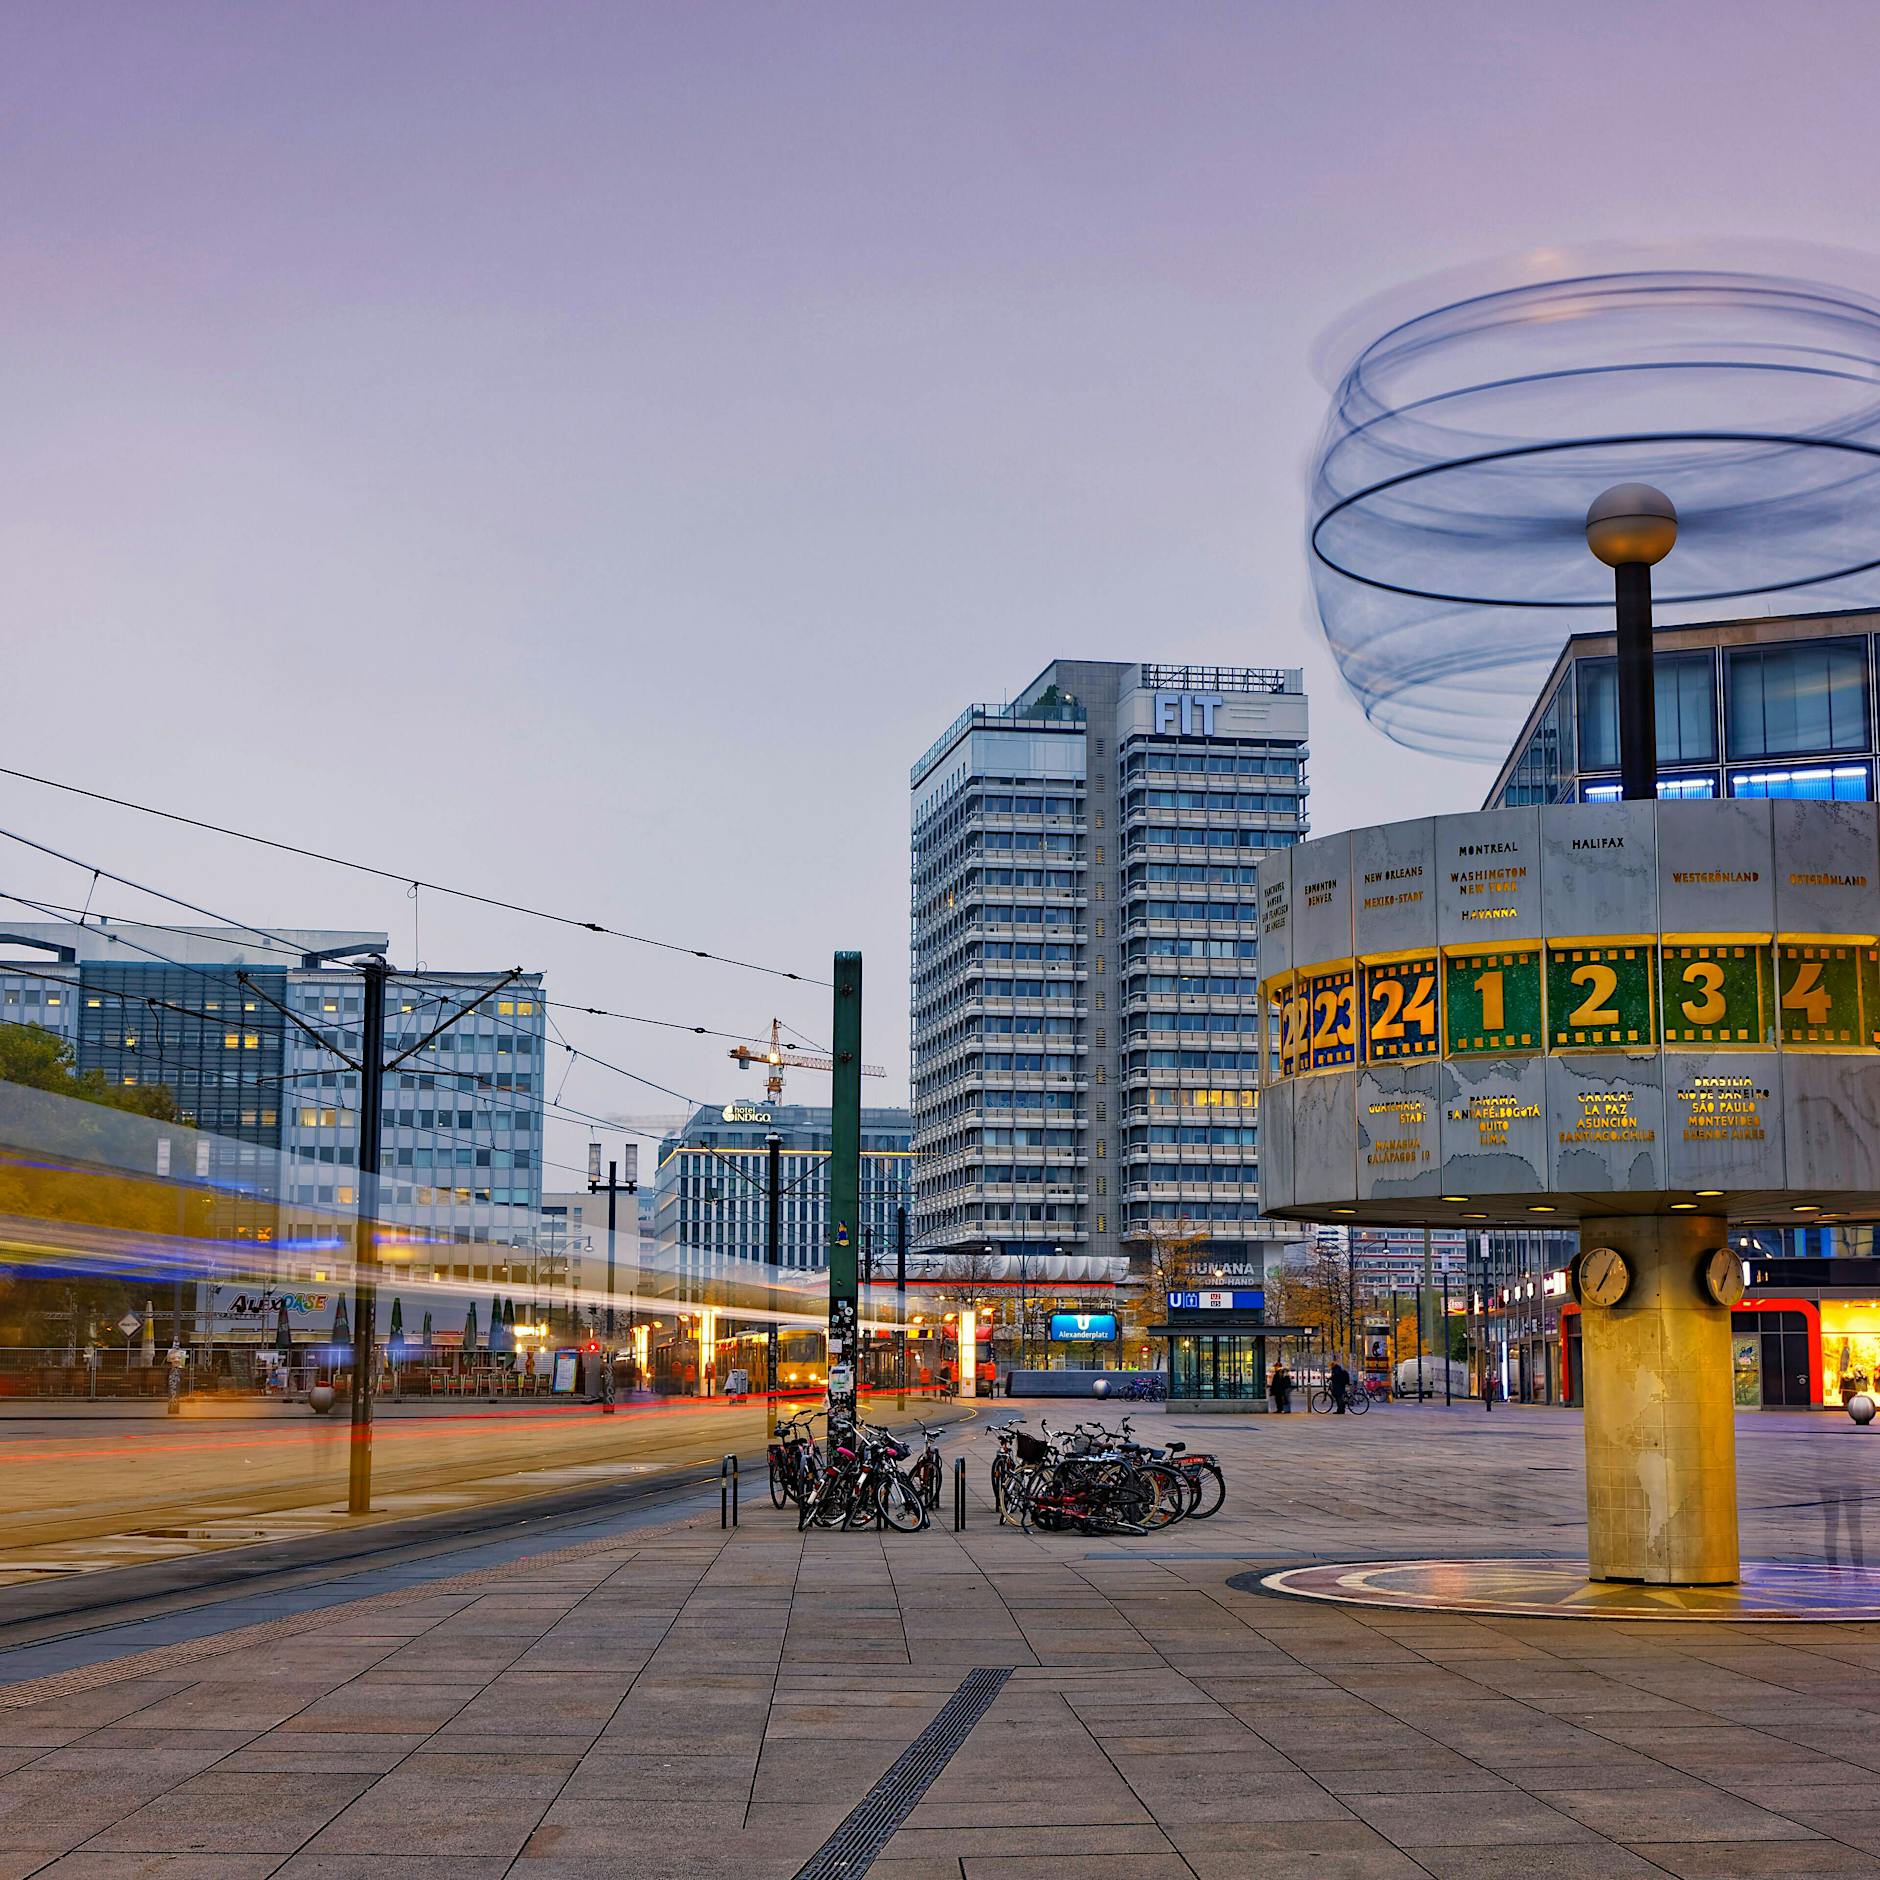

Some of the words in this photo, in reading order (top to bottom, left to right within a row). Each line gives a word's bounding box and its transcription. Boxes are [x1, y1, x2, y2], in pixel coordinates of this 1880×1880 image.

[1155, 693, 1223, 736] FIT
[1459, 842, 1518, 856] MONTREAL
[1572, 837, 1624, 850] HALIFAX
[1364, 872, 1382, 884] NEW
[1385, 866, 1423, 880] ORLEANS
[1450, 867, 1527, 882] WASHINGTON
[1672, 870, 1759, 883] WESTGRÖNLAND
[1304, 879, 1337, 895] EDMONTON
[1460, 883, 1485, 895] NEW
[1488, 881, 1519, 893] YORK
[1308, 892, 1333, 907] DENVER
[1364, 891, 1424, 909] MEXIKO-STADT
[1461, 907, 1518, 921] HAVANNA
[1569, 964, 1620, 1026] 2
[1681, 961, 1727, 1025] 3
[1782, 963, 1832, 1024] 4
[1474, 971, 1505, 1031] 1
[1371, 976, 1436, 1041] 24
[1314, 985, 1355, 1049] 23
[1282, 997, 1309, 1059] 22
[1469, 1095, 1518, 1106] PANAMA
[1577, 1091, 1634, 1102] CARACAS
[1677, 1089, 1697, 1100] RIO
[1699, 1089, 1714, 1100] DE
[1718, 1088, 1769, 1100] JANEIRO
[1584, 1104, 1600, 1115] LA
[1605, 1103, 1627, 1115] PAZ
[1692, 1099, 1715, 1113] SÃO
[1719, 1102, 1756, 1113] PAULO
[1479, 1121, 1509, 1132] QUITO
[1576, 1115, 1637, 1129] ASUNCIÓN
[1688, 1116, 1760, 1127] MONTEVIDEO
[1683, 1129, 1728, 1141] BUENOS
[1732, 1129, 1765, 1141] AIRES
[1184, 1262, 1255, 1275] HUMANA
[1169, 1292, 1182, 1308] U
[1076, 1314, 1090, 1331] U
[1058, 1330, 1109, 1340] Alexanderplatz
